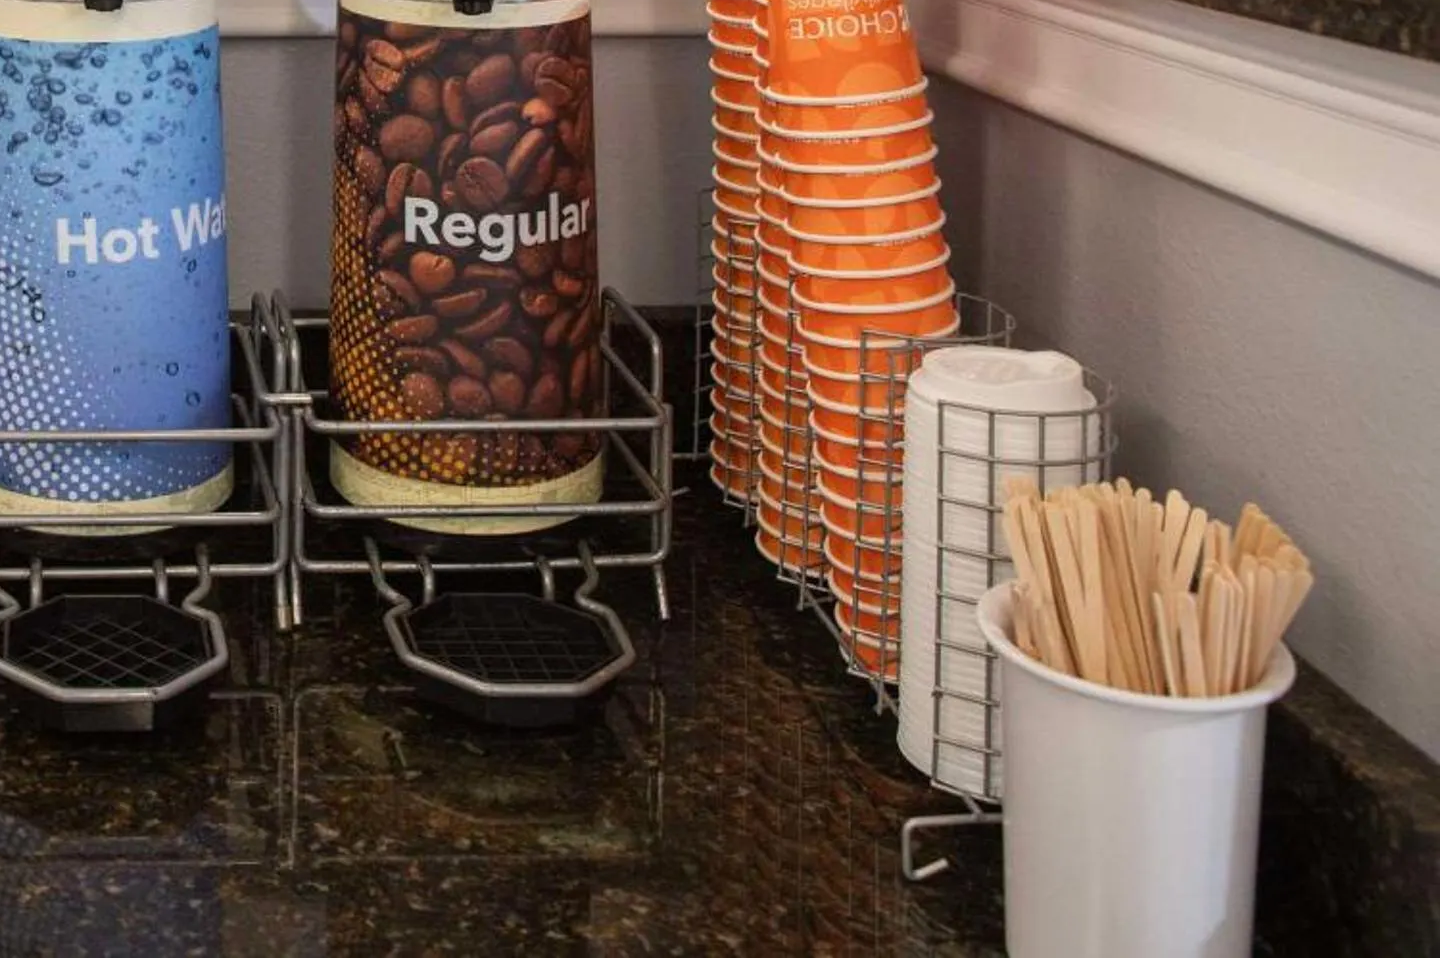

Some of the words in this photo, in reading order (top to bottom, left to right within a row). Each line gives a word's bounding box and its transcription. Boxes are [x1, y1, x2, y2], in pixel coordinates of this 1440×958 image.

[789, 9, 898, 40] CHOICE
[56, 216, 159, 264] Hot
[404, 192, 590, 262] Regular
